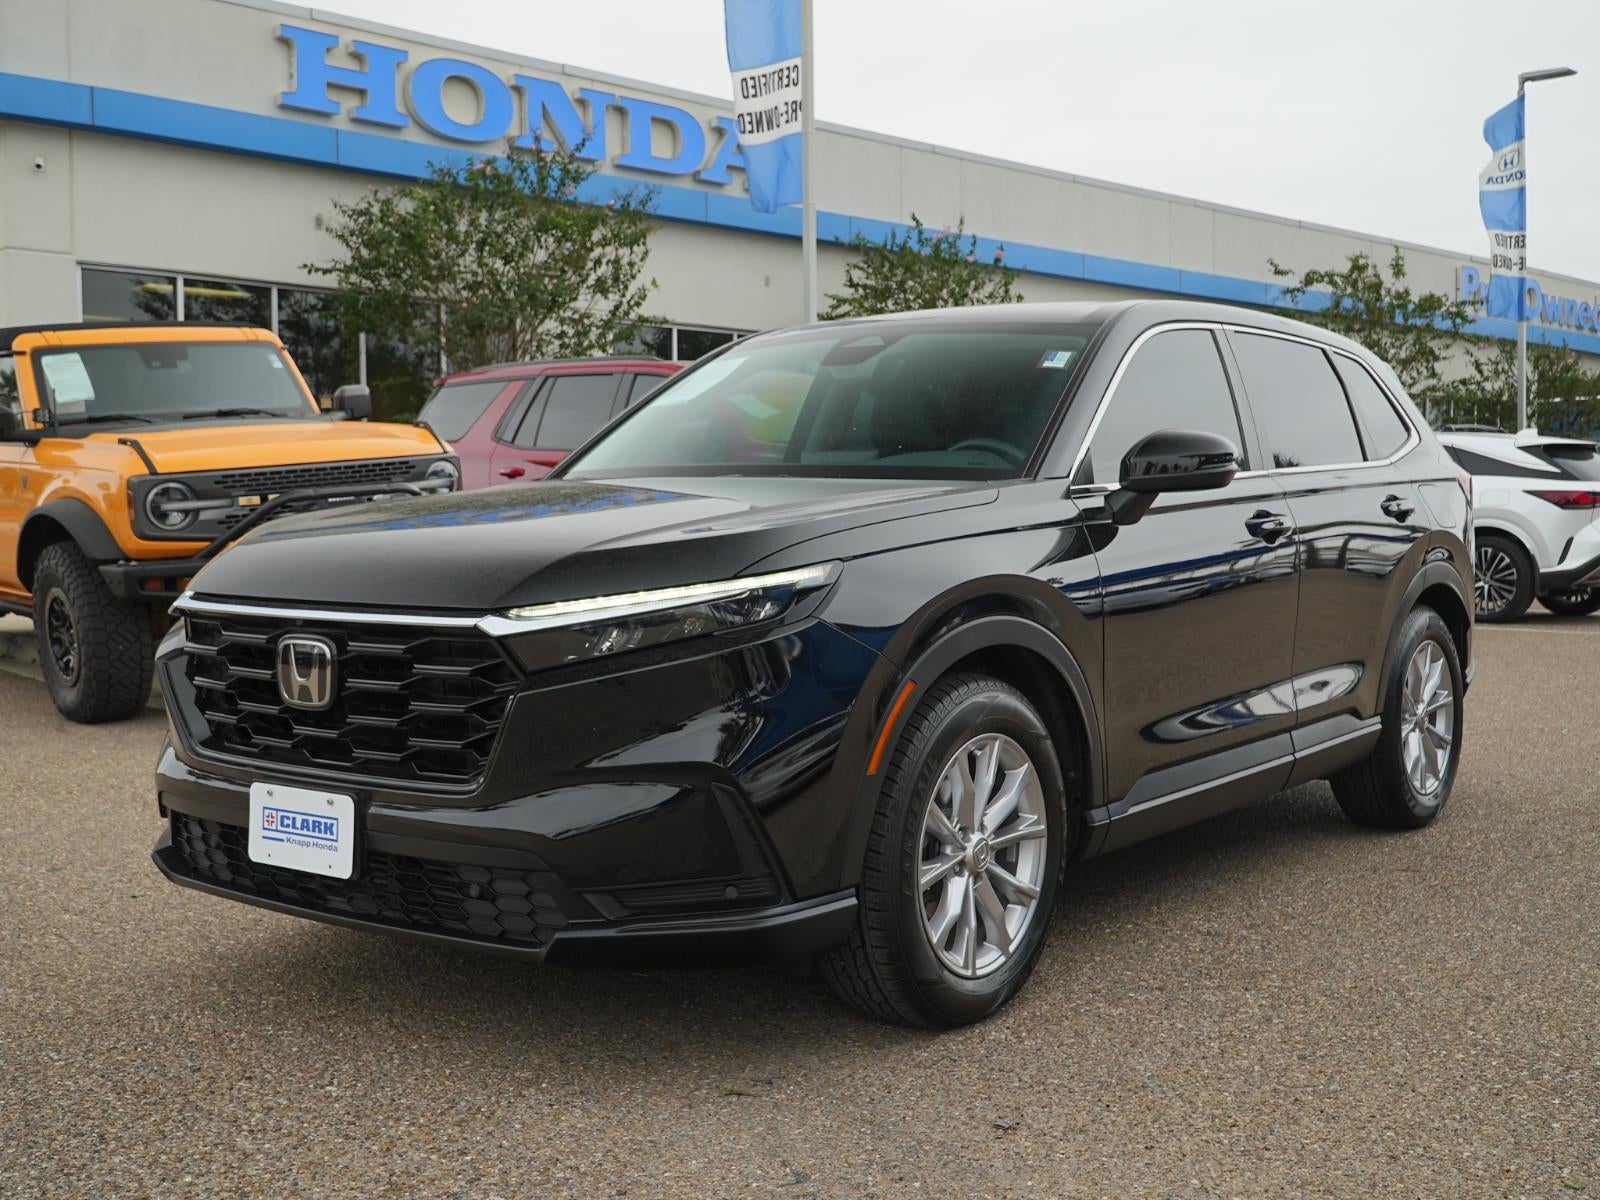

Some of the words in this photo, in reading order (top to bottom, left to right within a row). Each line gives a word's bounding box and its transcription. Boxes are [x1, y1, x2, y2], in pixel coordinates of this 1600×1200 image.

[280, 815, 335, 836] CLARK
[286, 837, 311, 849] Knapp
[312, 841, 338, 852] Honda
